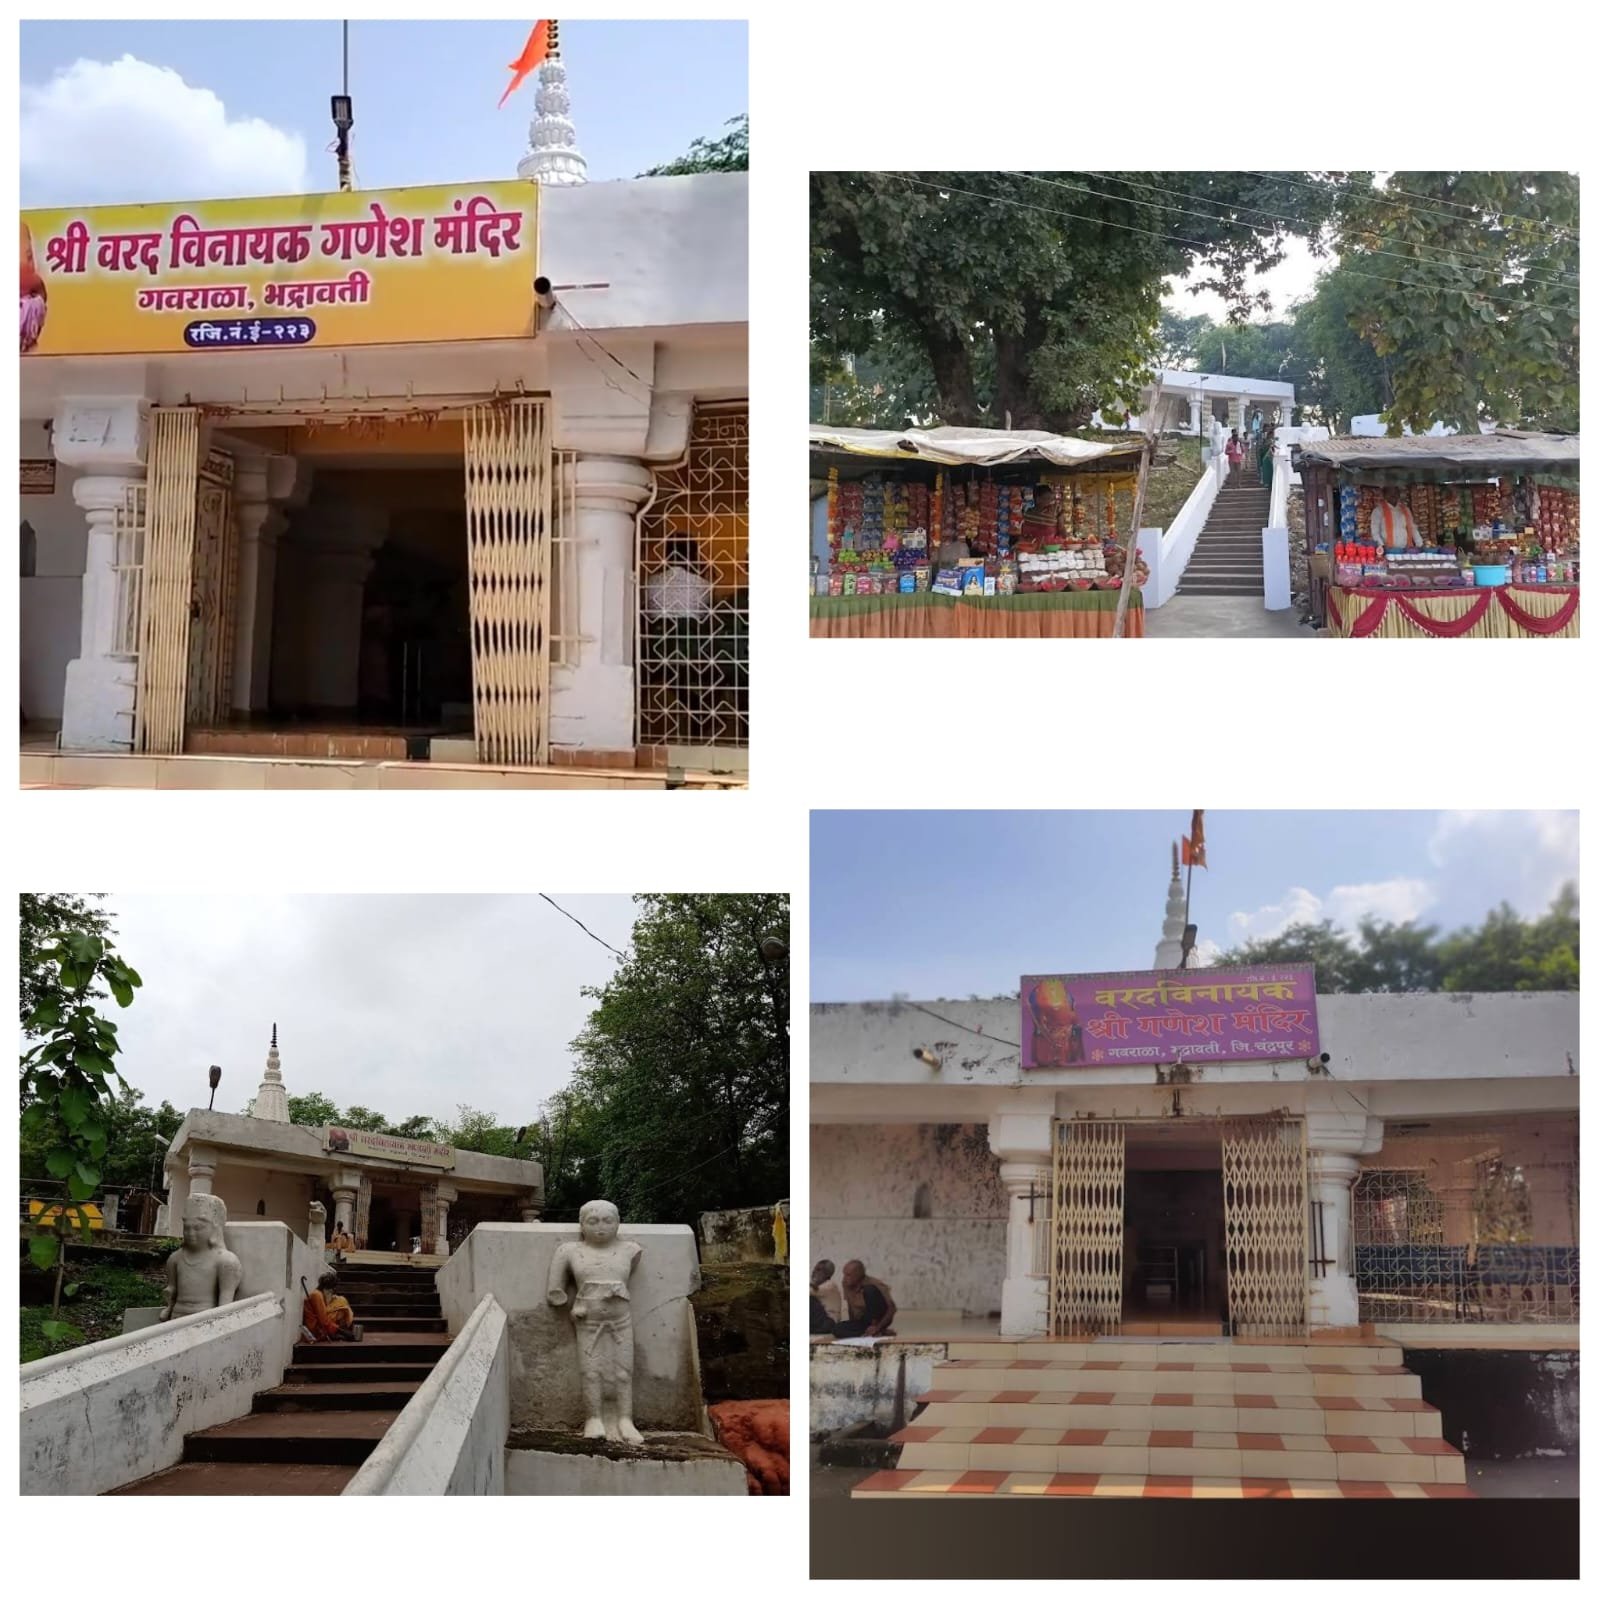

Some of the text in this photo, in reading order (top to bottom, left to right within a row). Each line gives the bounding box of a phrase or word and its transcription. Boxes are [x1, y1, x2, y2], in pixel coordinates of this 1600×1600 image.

[46, 195, 523, 275] श्री वरद विनायक गणेश मंदिर
[138, 270, 370, 312] गवराळा, भद्रावती
[1095, 980, 1297, 1009] वरदविनायक
[1086, 1004, 1313, 1039] श्री गणेश मंदिर
